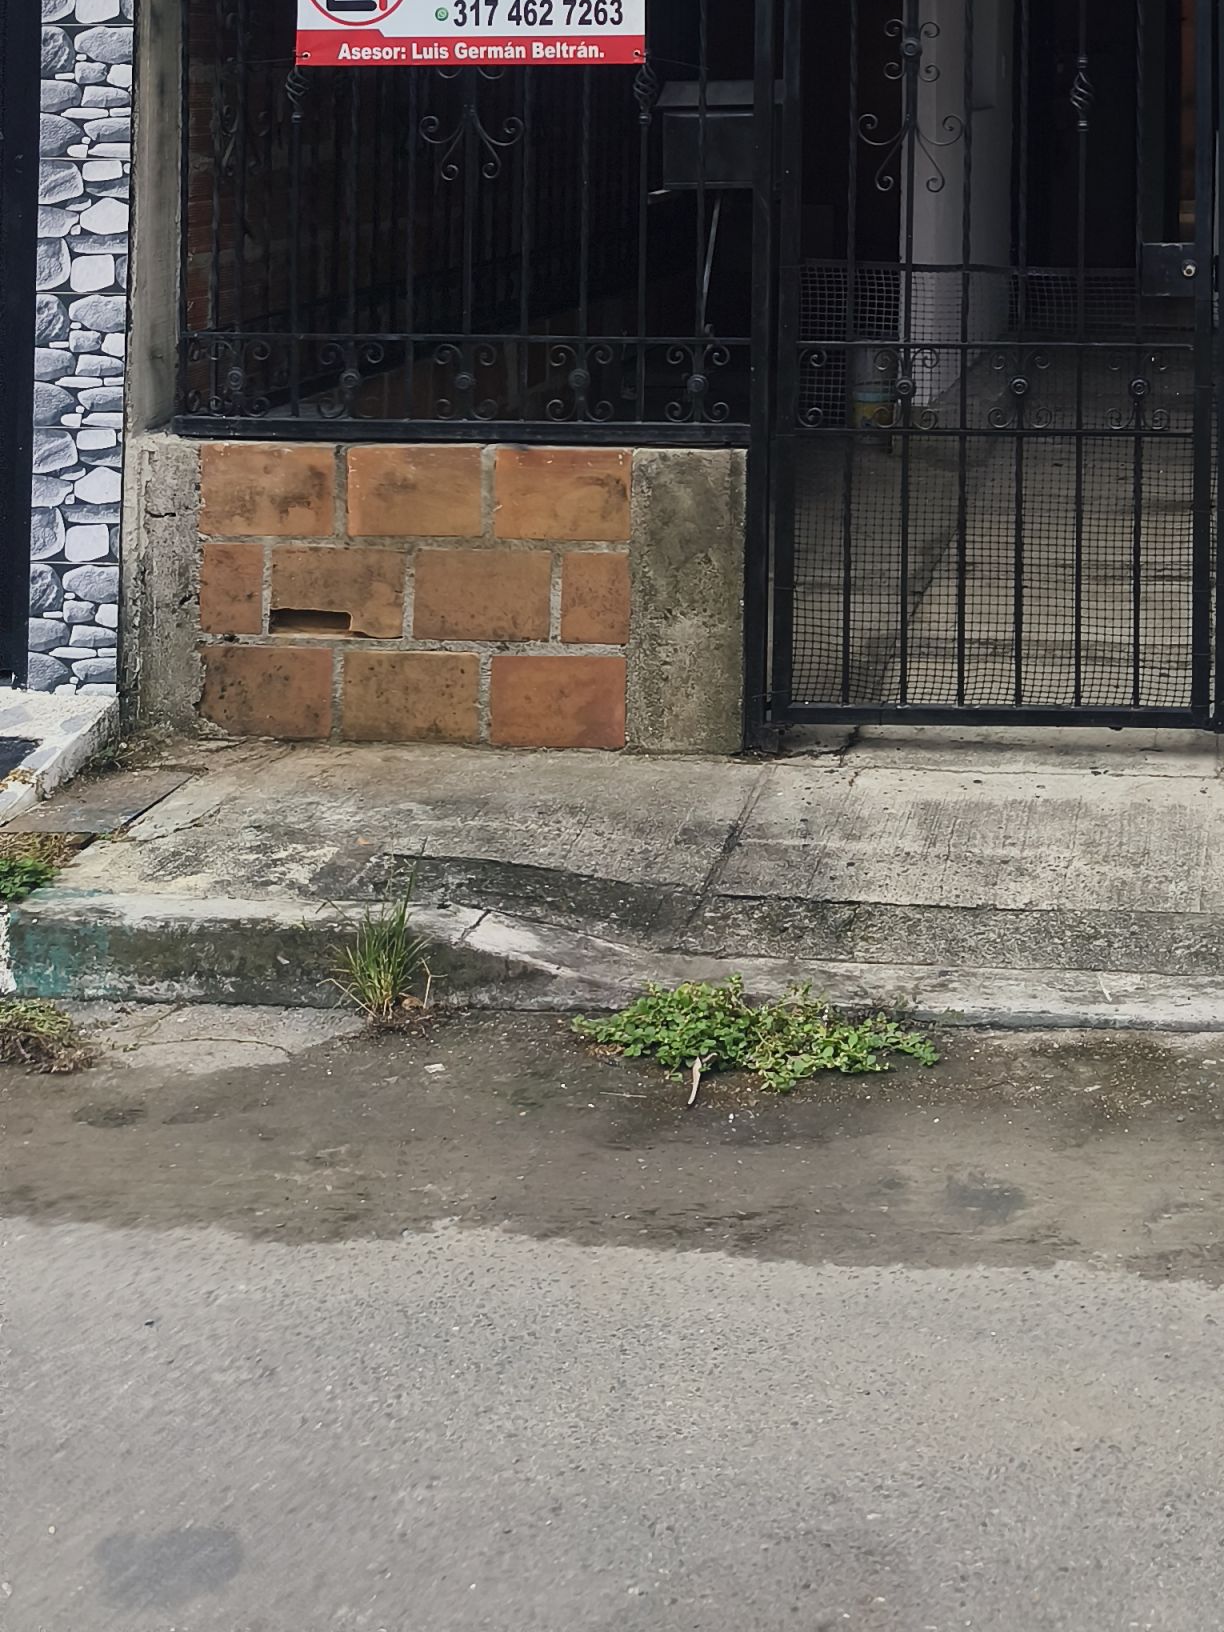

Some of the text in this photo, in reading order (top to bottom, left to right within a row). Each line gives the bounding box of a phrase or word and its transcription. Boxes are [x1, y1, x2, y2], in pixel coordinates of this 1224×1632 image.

[453, 0, 499, 27] 317
[507, 0, 553, 27] 462
[338, 41, 605, 61] Asesor: Luis Germán Beltrán.
